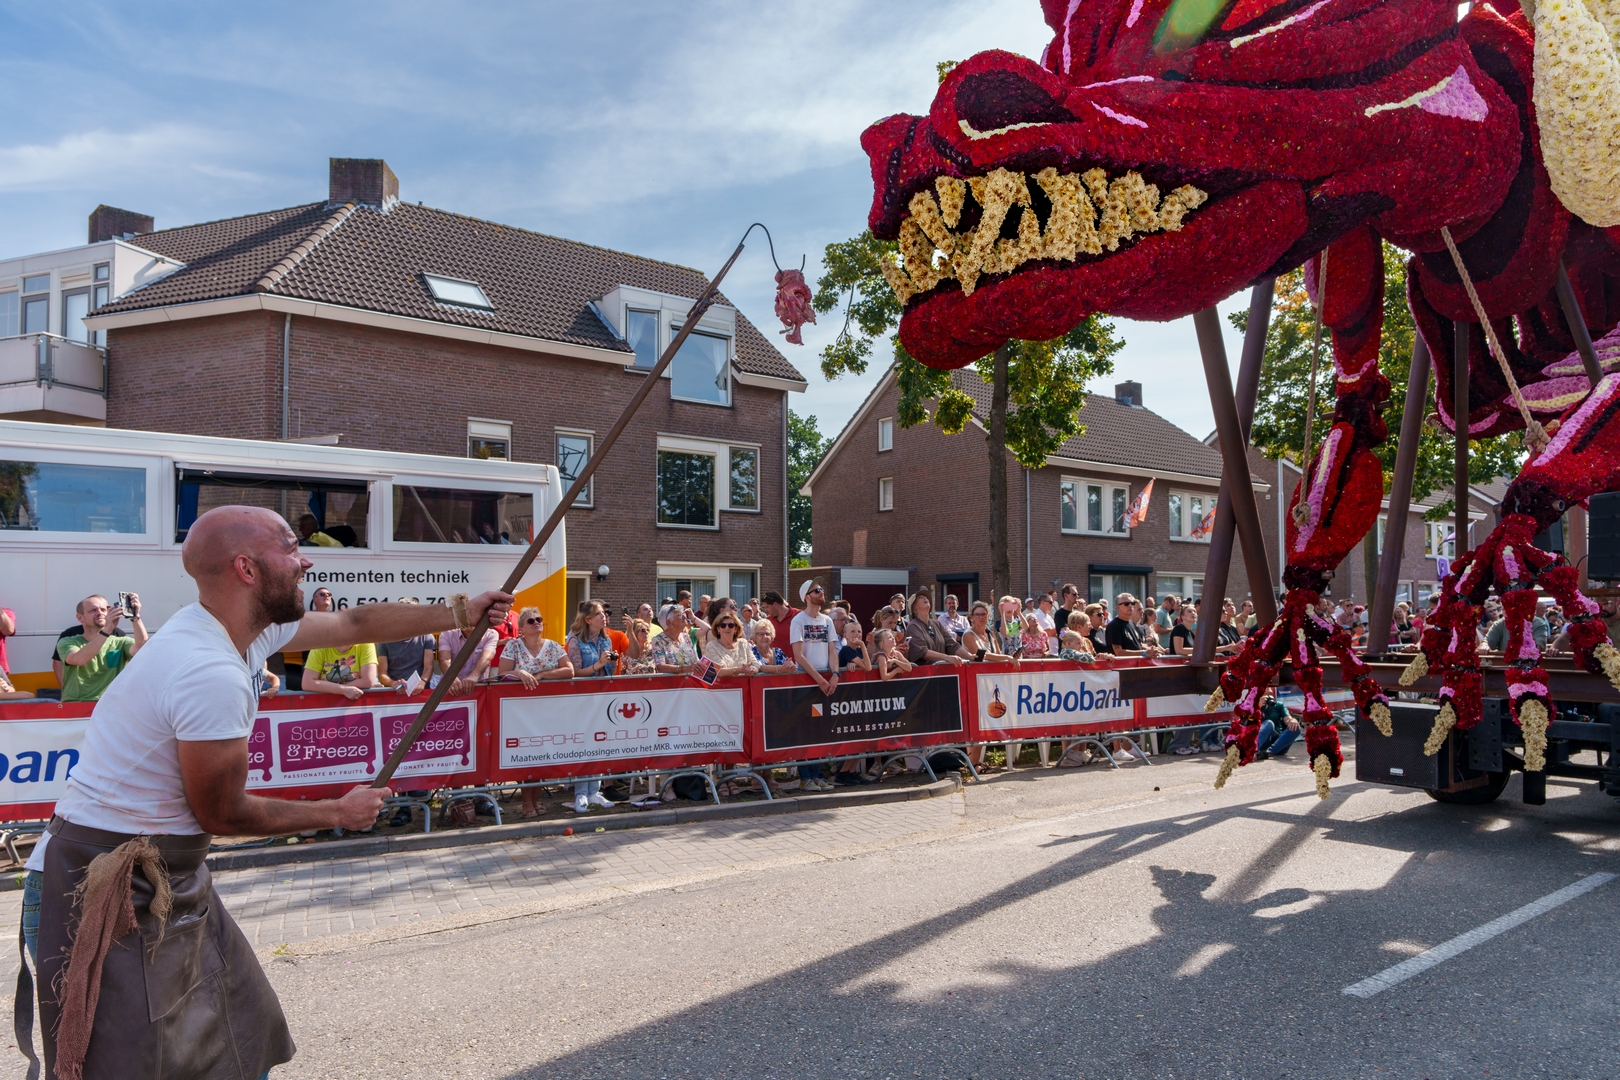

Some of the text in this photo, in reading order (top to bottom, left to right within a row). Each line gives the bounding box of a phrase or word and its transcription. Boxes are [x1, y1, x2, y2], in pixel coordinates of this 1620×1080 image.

[400, 570, 470, 583] techniek
[830, 696, 906, 716] SOMNIUM
[291, 725, 369, 743] Squeeze
[392, 719, 465, 735] Seeze
[836, 721, 902, 734] REAL ESTATE
[594, 728, 649, 742] CLOUD
[303, 745, 369, 760] Freeze
[408, 737, 464, 753] reeze
[510, 752, 551, 763] Maatwerk
[552, 747, 620, 760] cloudoplossingen
[640, 745, 652, 753] het
[653, 742, 672, 751] MKB.
[673, 739, 736, 750] www.bespokecs.nl
[397, 763, 424, 771] SIONATE
[283, 771, 326, 779] PASSIONATE
